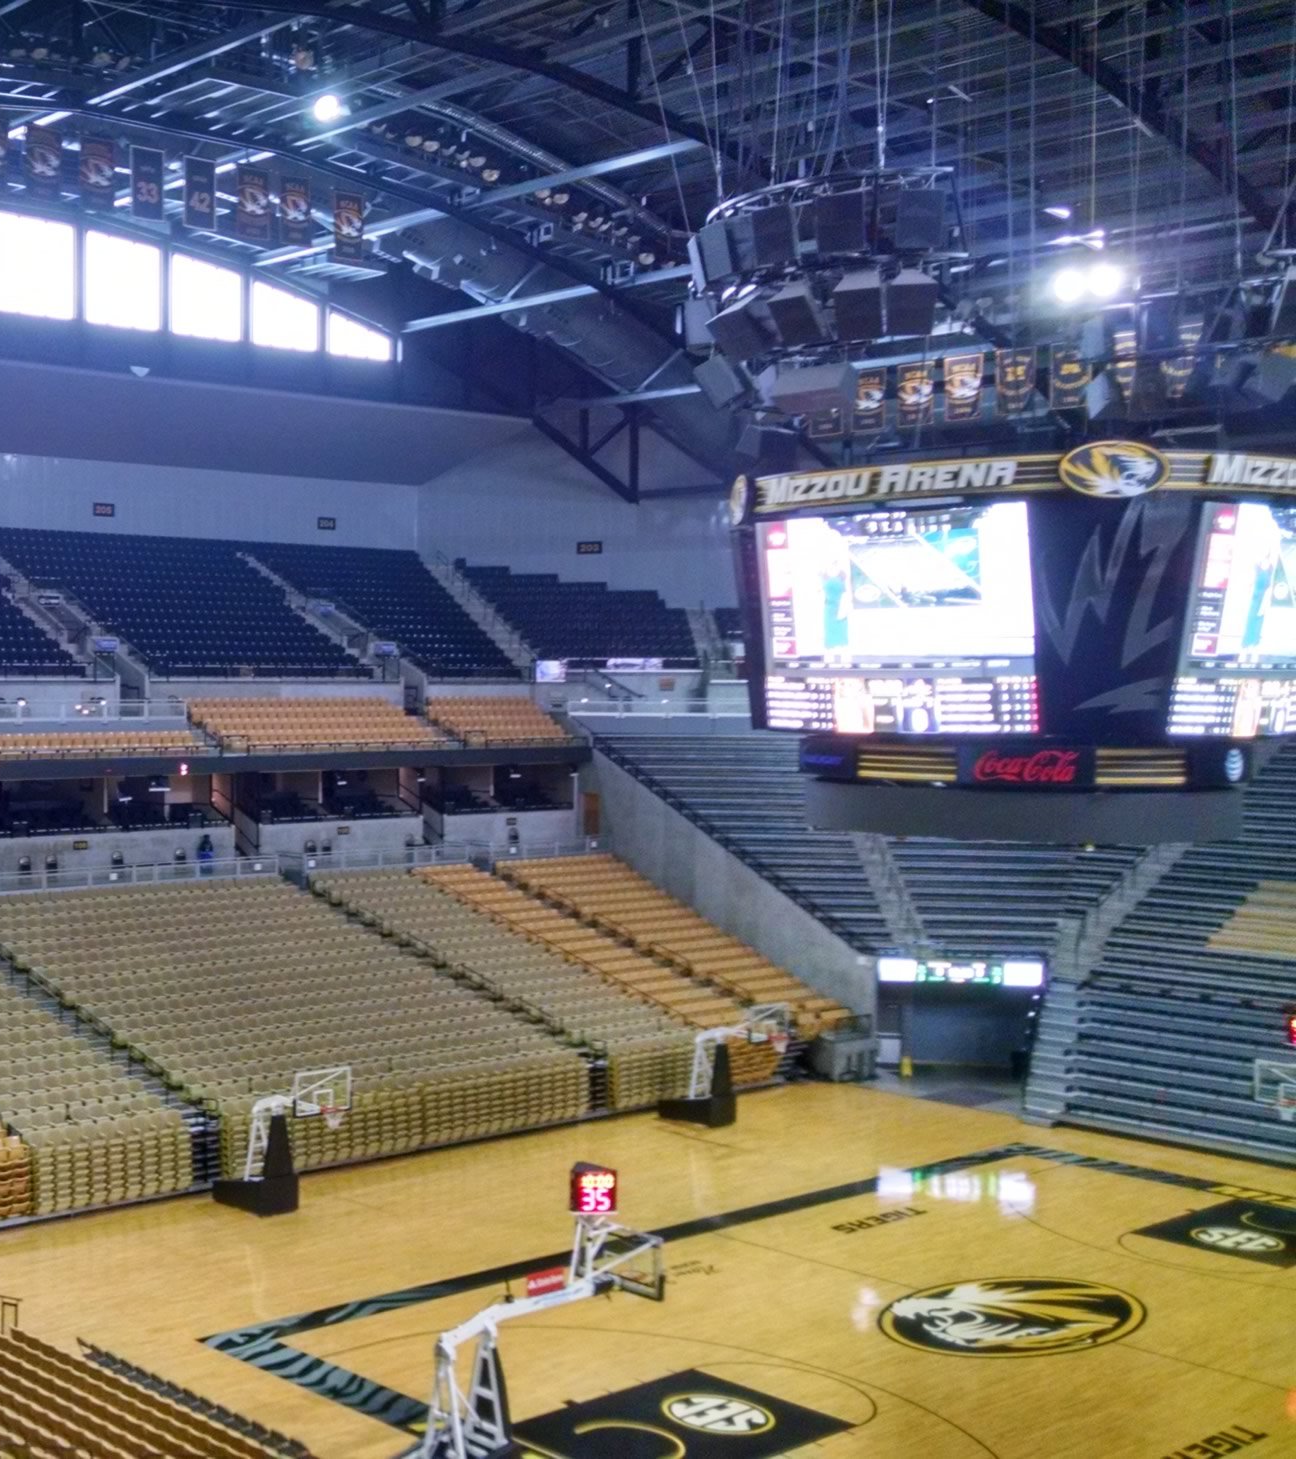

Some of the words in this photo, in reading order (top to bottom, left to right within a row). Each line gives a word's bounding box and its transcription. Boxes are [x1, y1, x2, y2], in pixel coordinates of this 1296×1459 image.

[190, 191, 211, 213] 42
[581, 1189, 611, 1212] 35
[831, 1207, 928, 1234] TIGERS
[1196, 1227, 1279, 1250] SEC
[670, 1396, 768, 1431] SEC
